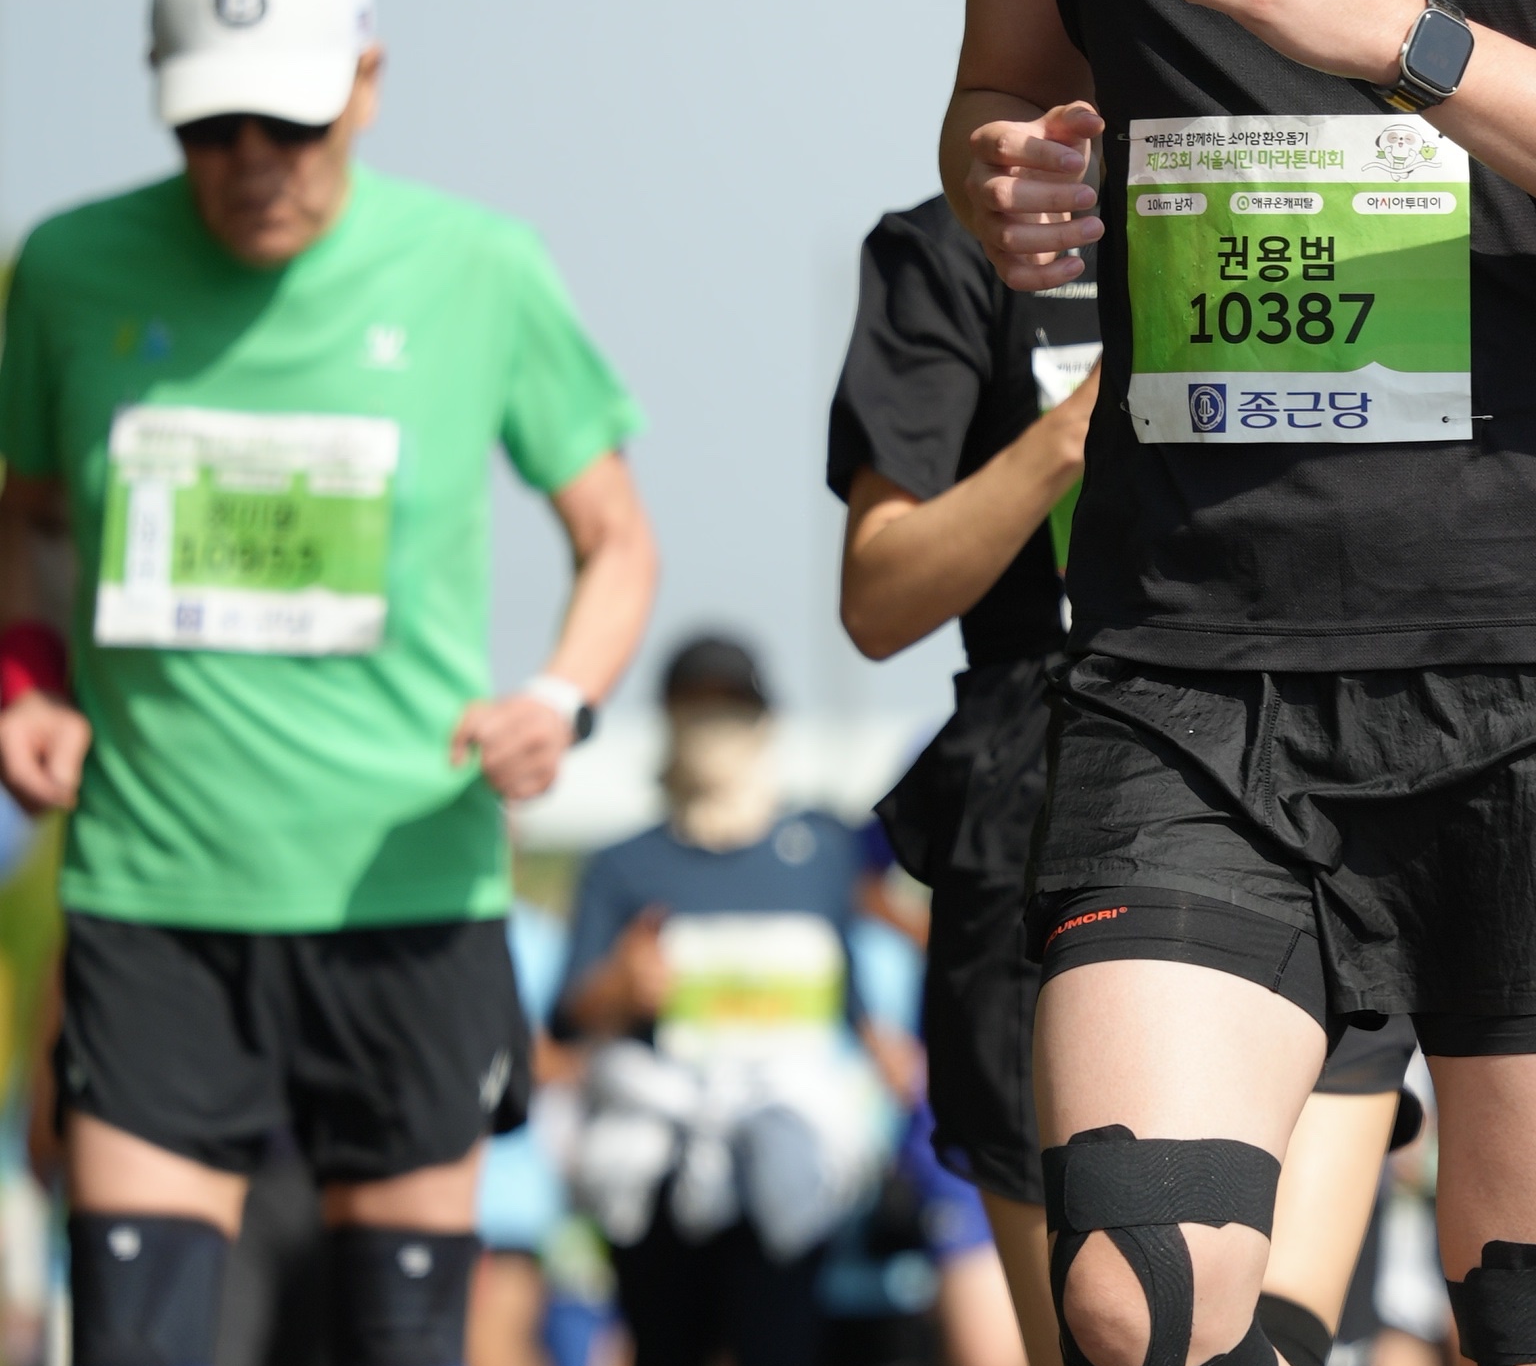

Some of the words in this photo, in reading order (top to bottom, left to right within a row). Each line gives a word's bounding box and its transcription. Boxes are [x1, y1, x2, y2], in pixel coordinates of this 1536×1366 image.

[1186, 132, 1226, 147] 함께하는
[1146, 150, 1192, 171] 제23회
[1197, 150, 1254, 170] 서울시민
[1257, 149, 1344, 170] 마라톤대회
[1147, 199, 1172, 211] 10km
[1174, 198, 1194, 211] 남자
[1251, 197, 1314, 210] 애큐온캐피탈
[1366, 197, 1441, 209] 아시아투데이
[1217, 235, 1336, 283] 권용범
[1189, 292, 1376, 345] 10387
[1237, 391, 1373, 430] 종근당
